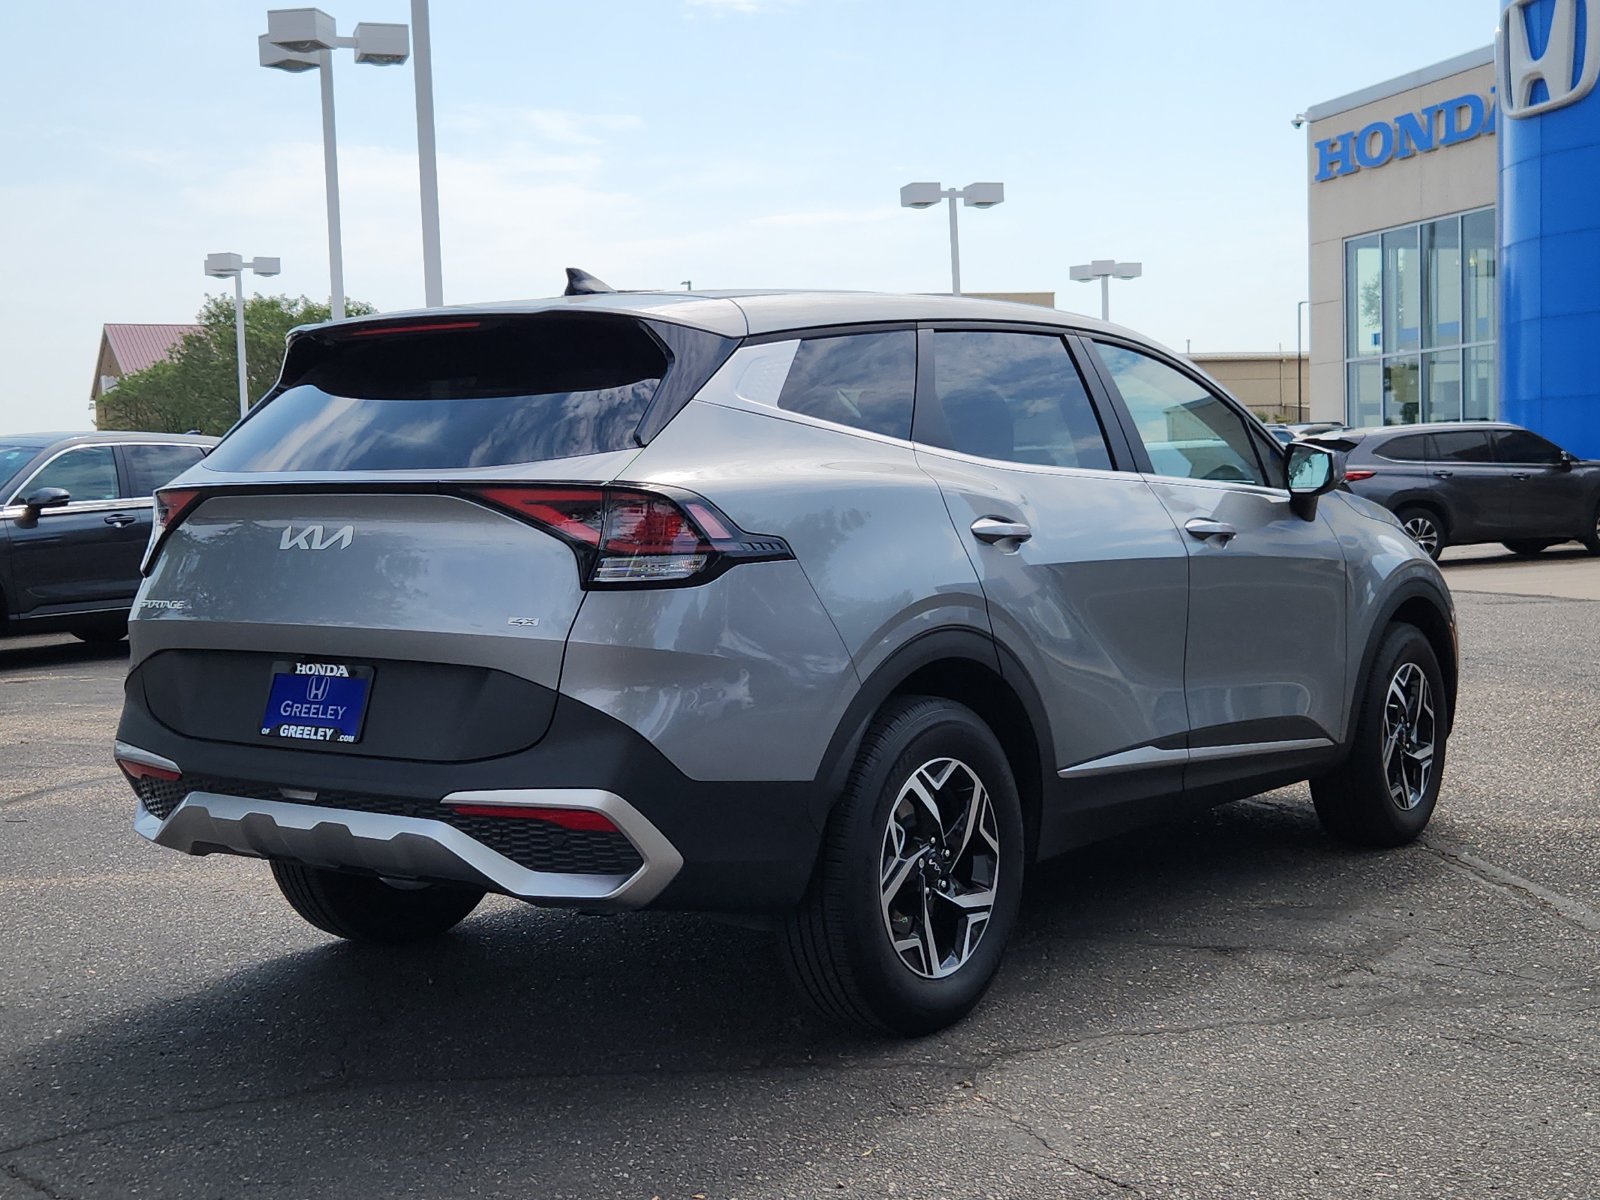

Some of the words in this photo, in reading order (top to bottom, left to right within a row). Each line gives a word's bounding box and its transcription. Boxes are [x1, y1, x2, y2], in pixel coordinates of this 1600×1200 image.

[279, 525, 354, 550] KIA
[295, 662, 350, 677] HONDA
[280, 700, 347, 720] GREELEY
[261, 727, 271, 735] OF
[279, 724, 335, 741] GREELEY
